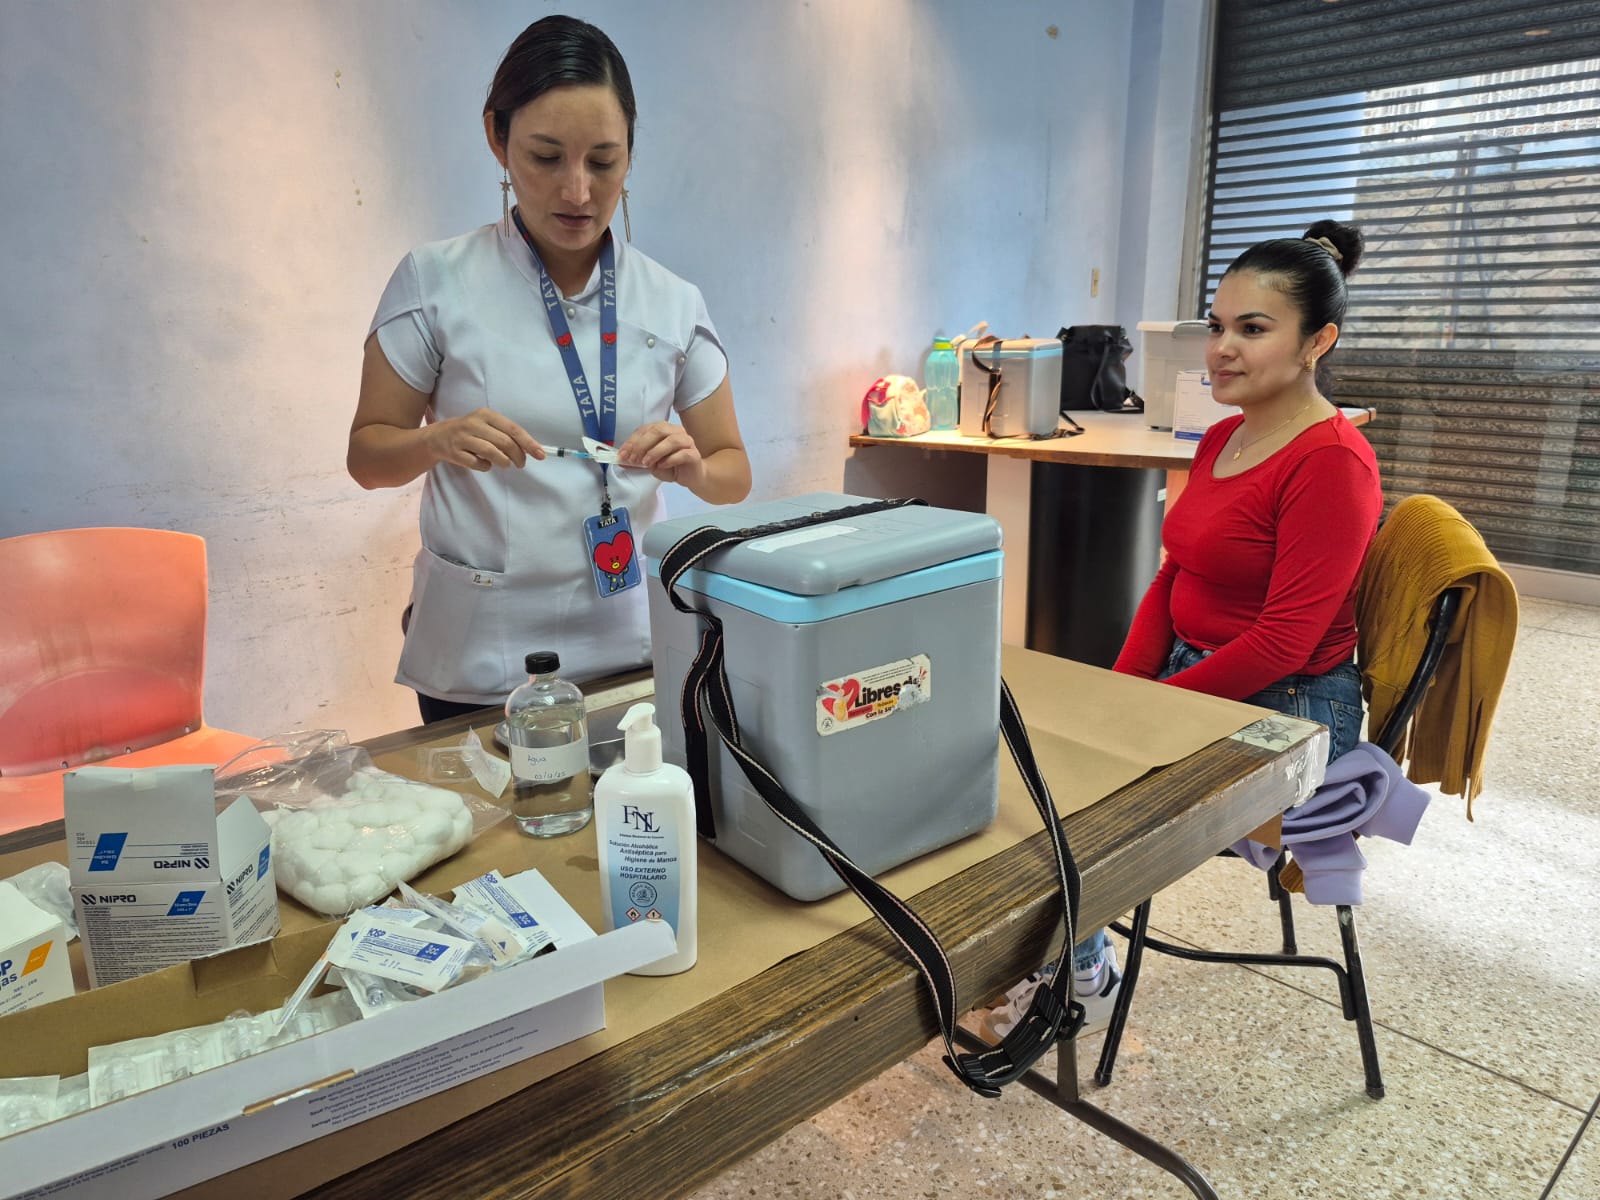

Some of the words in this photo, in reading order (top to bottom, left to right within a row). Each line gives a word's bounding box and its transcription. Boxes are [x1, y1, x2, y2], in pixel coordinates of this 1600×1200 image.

[603, 268, 616, 307] TATA
[572, 375, 595, 418] TATA
[603, 374, 616, 414] TATA
[600, 517, 617, 528] TATA
[855, 683, 901, 707] Libres
[527, 753, 548, 766] Agua
[621, 804, 661, 833] FNL
[153, 859, 191, 869] NIPRO
[235, 863, 254, 886] NIPRO
[620, 865, 634, 873] USO
[634, 866, 666, 874] EXTERNO
[619, 872, 668, 881] HOSPITALARIO
[99, 894, 137, 904] NIPRO
[171, 1137, 190, 1150] 100
[191, 1123, 230, 1143] PIEZAS
